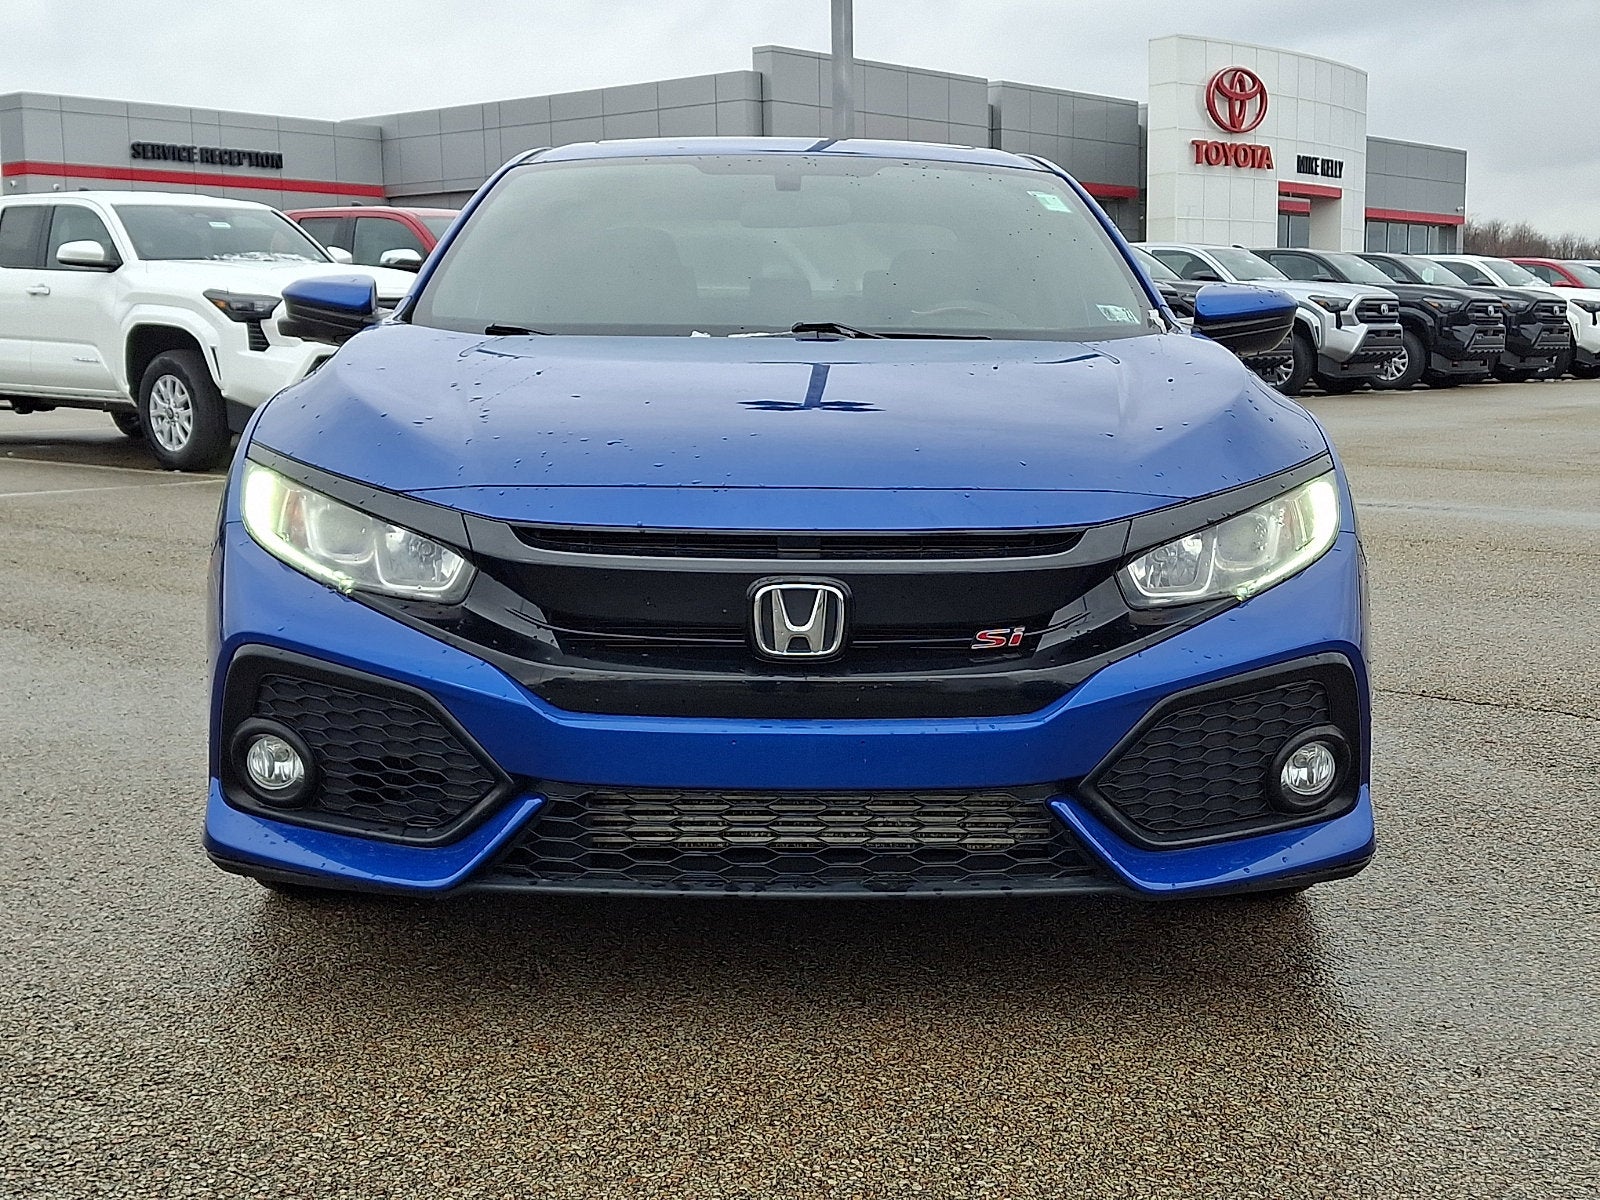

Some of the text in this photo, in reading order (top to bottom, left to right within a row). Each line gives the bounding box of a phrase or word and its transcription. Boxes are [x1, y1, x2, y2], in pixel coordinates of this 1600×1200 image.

[131, 141, 283, 169] SERVICE RECEPTION
[1191, 140, 1274, 170] TOYOTA
[1297, 155, 1343, 179] MIKE KELLY
[971, 626, 1026, 649] Si
